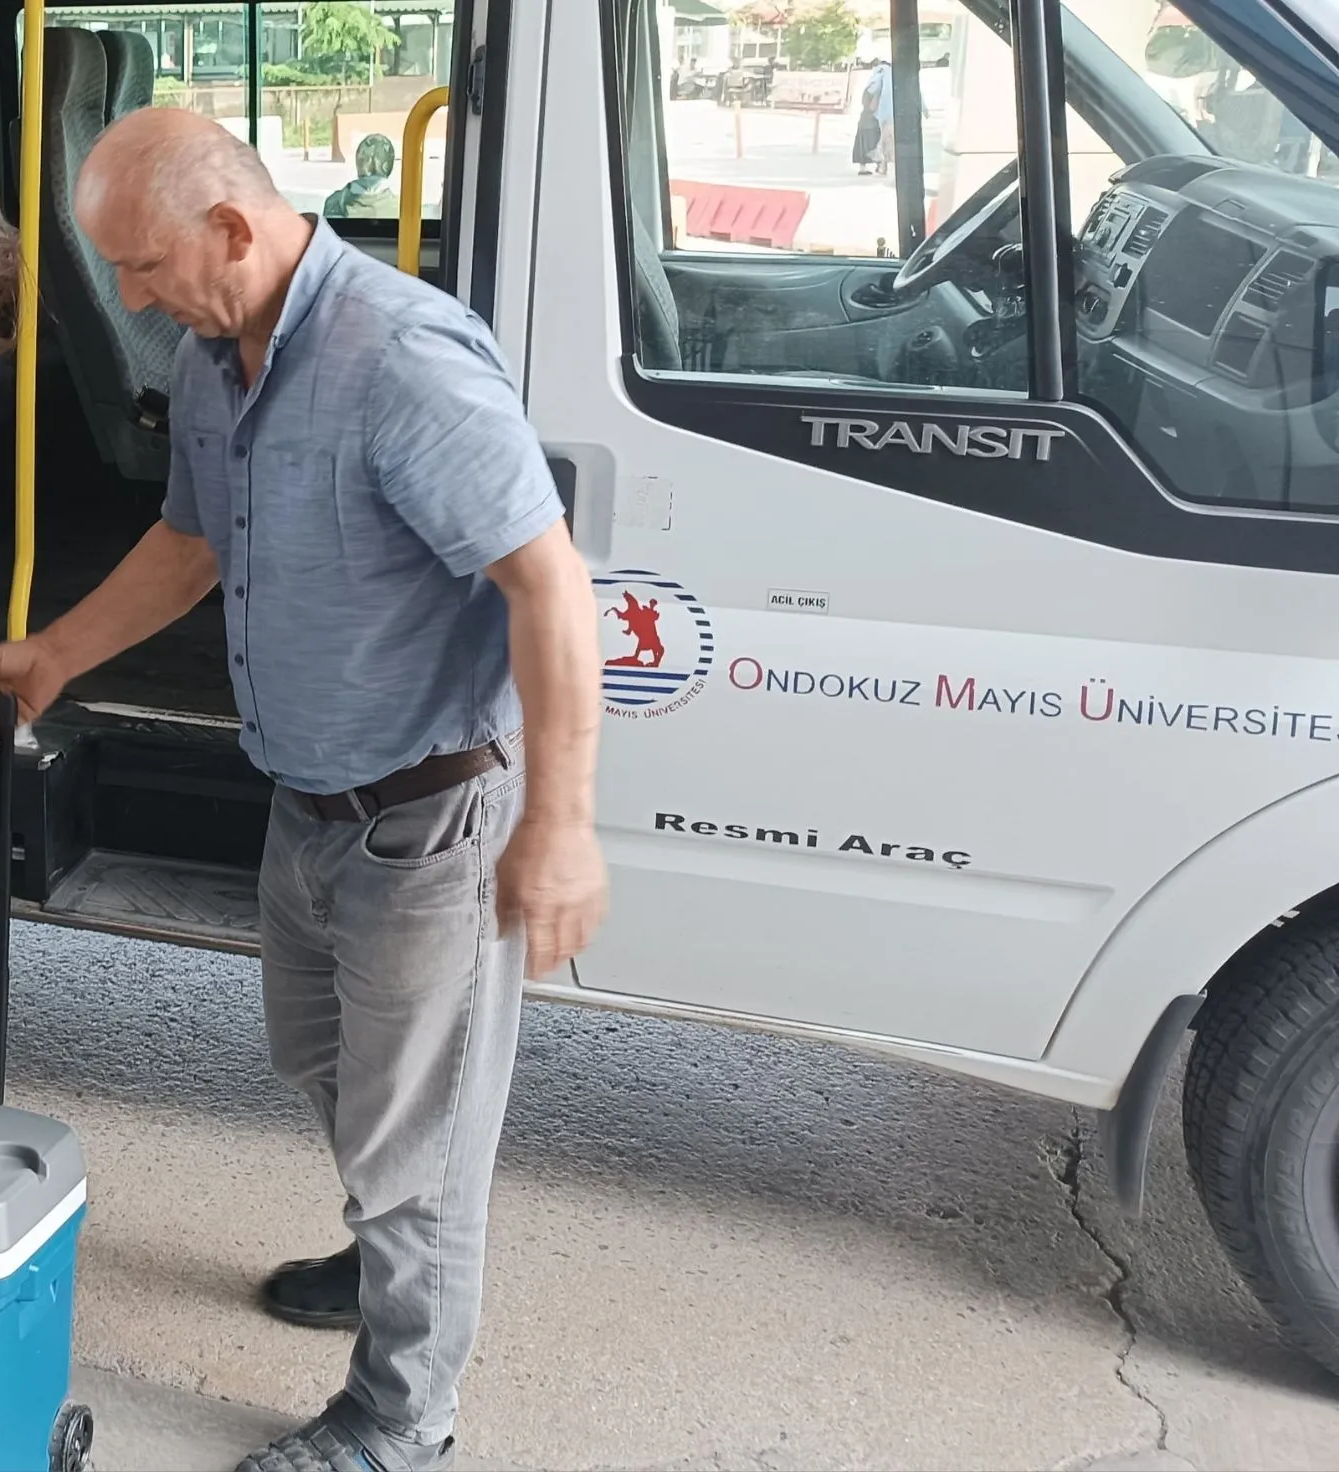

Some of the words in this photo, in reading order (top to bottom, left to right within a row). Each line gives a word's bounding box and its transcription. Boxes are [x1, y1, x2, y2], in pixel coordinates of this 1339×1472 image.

[801, 415, 1065, 461] TRANSIT
[770, 594, 794, 605] ACİL
[797, 597, 826, 609] ÇIKIŞ
[605, 705, 638, 719] MAYIS
[729, 657, 921, 706] ONDOKUZ
[935, 674, 1062, 717] MAYIS
[1080, 677, 1339, 742] ÜNİVERSİTE
[655, 812, 818, 848] Resmi
[838, 834, 972, 870] Araç
